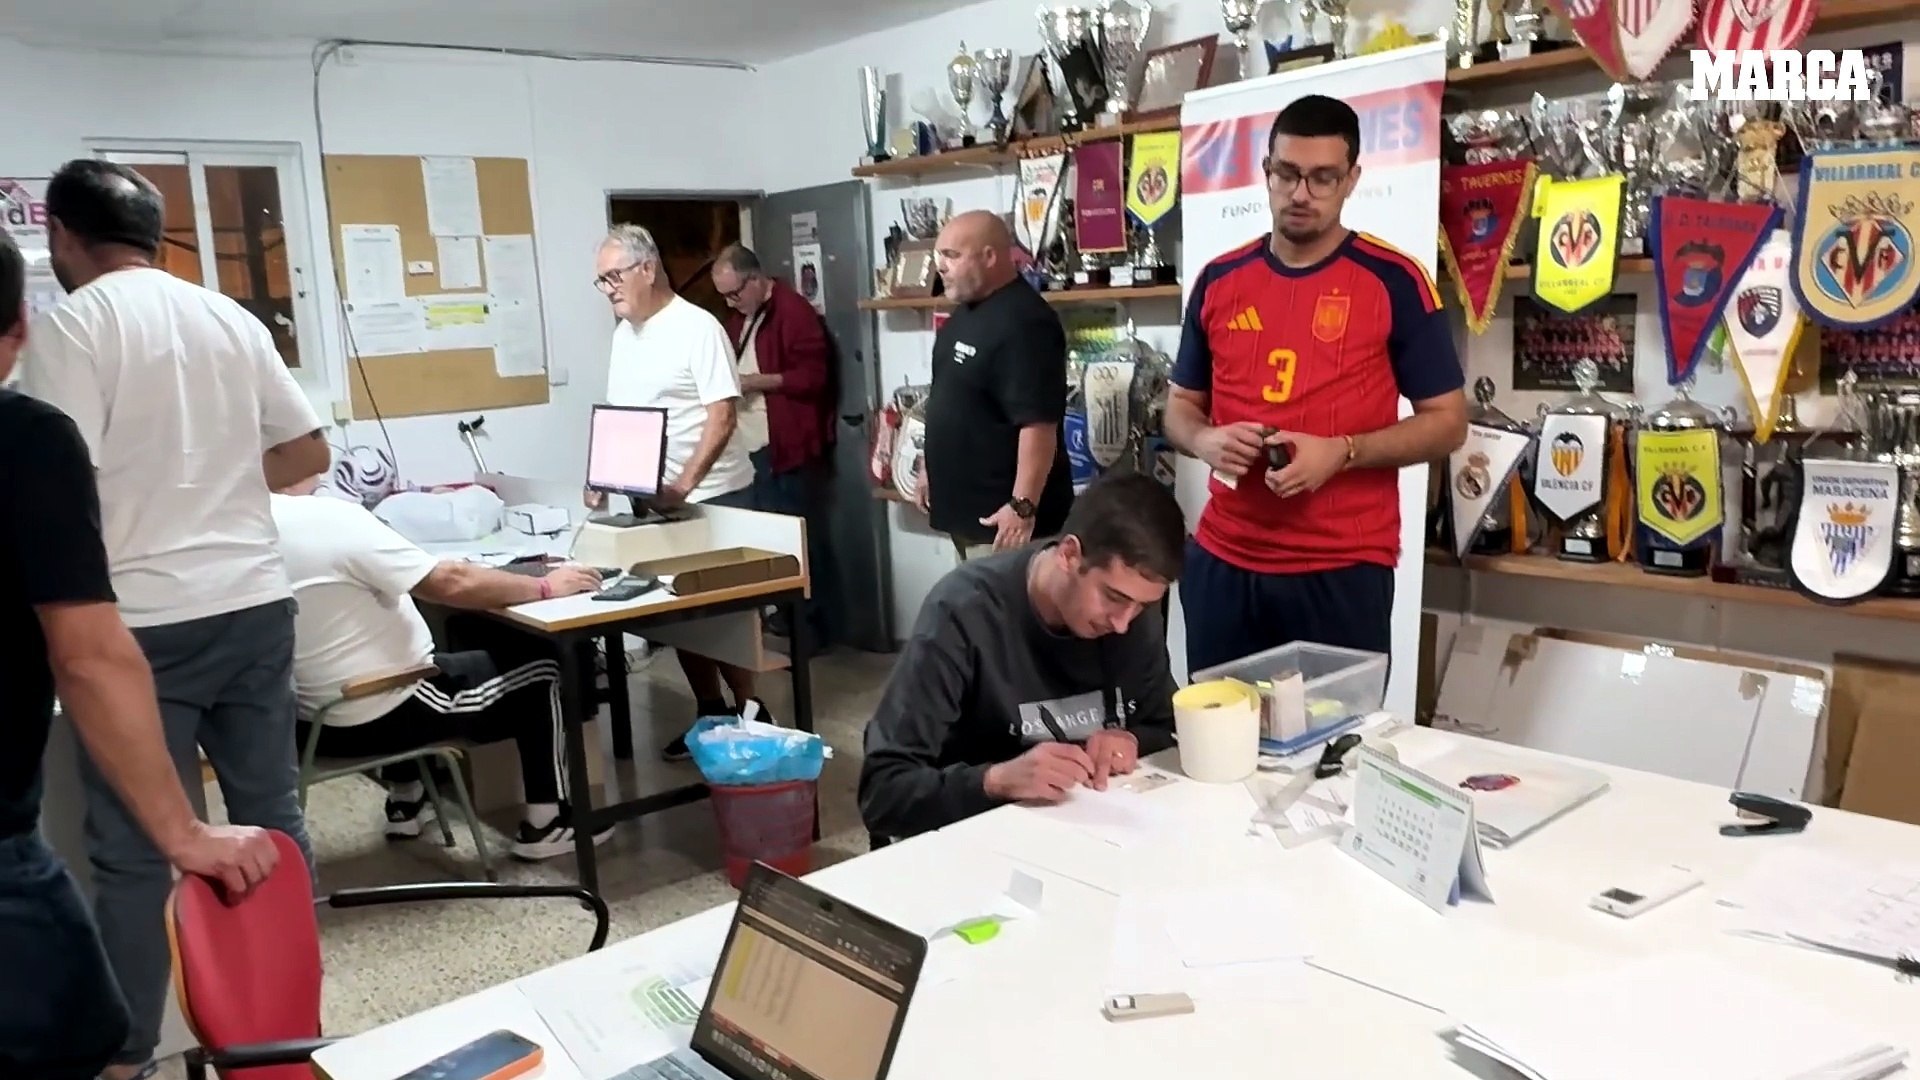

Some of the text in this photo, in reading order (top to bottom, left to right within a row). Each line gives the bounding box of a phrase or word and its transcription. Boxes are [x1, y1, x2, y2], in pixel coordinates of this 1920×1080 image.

[1461, 169, 1523, 190] TAVERNES
[1262, 348, 1297, 403] 3
[1812, 484, 1889, 500] MARACENA
[1056, 699, 1137, 730] ANGEES
